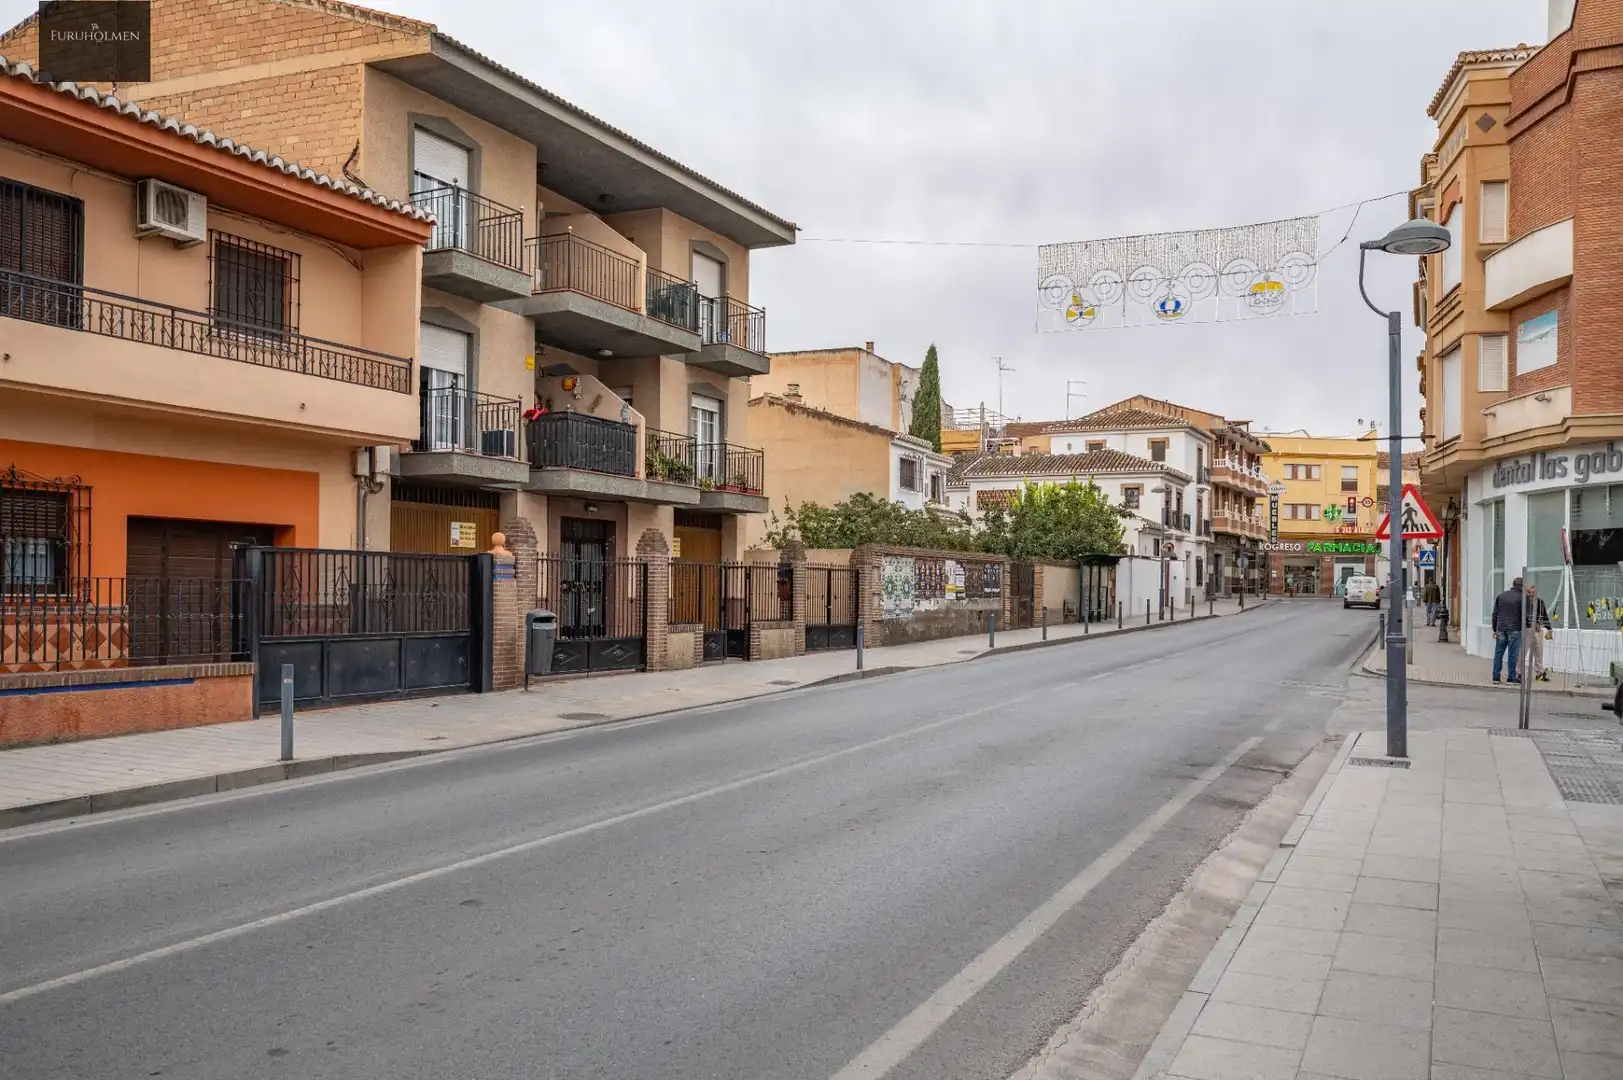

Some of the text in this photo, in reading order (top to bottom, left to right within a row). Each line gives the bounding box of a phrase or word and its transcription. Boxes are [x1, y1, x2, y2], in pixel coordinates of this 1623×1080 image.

[1493, 441, 1623, 489] dental las gab
[1306, 541, 1375, 553] FARMACIA
